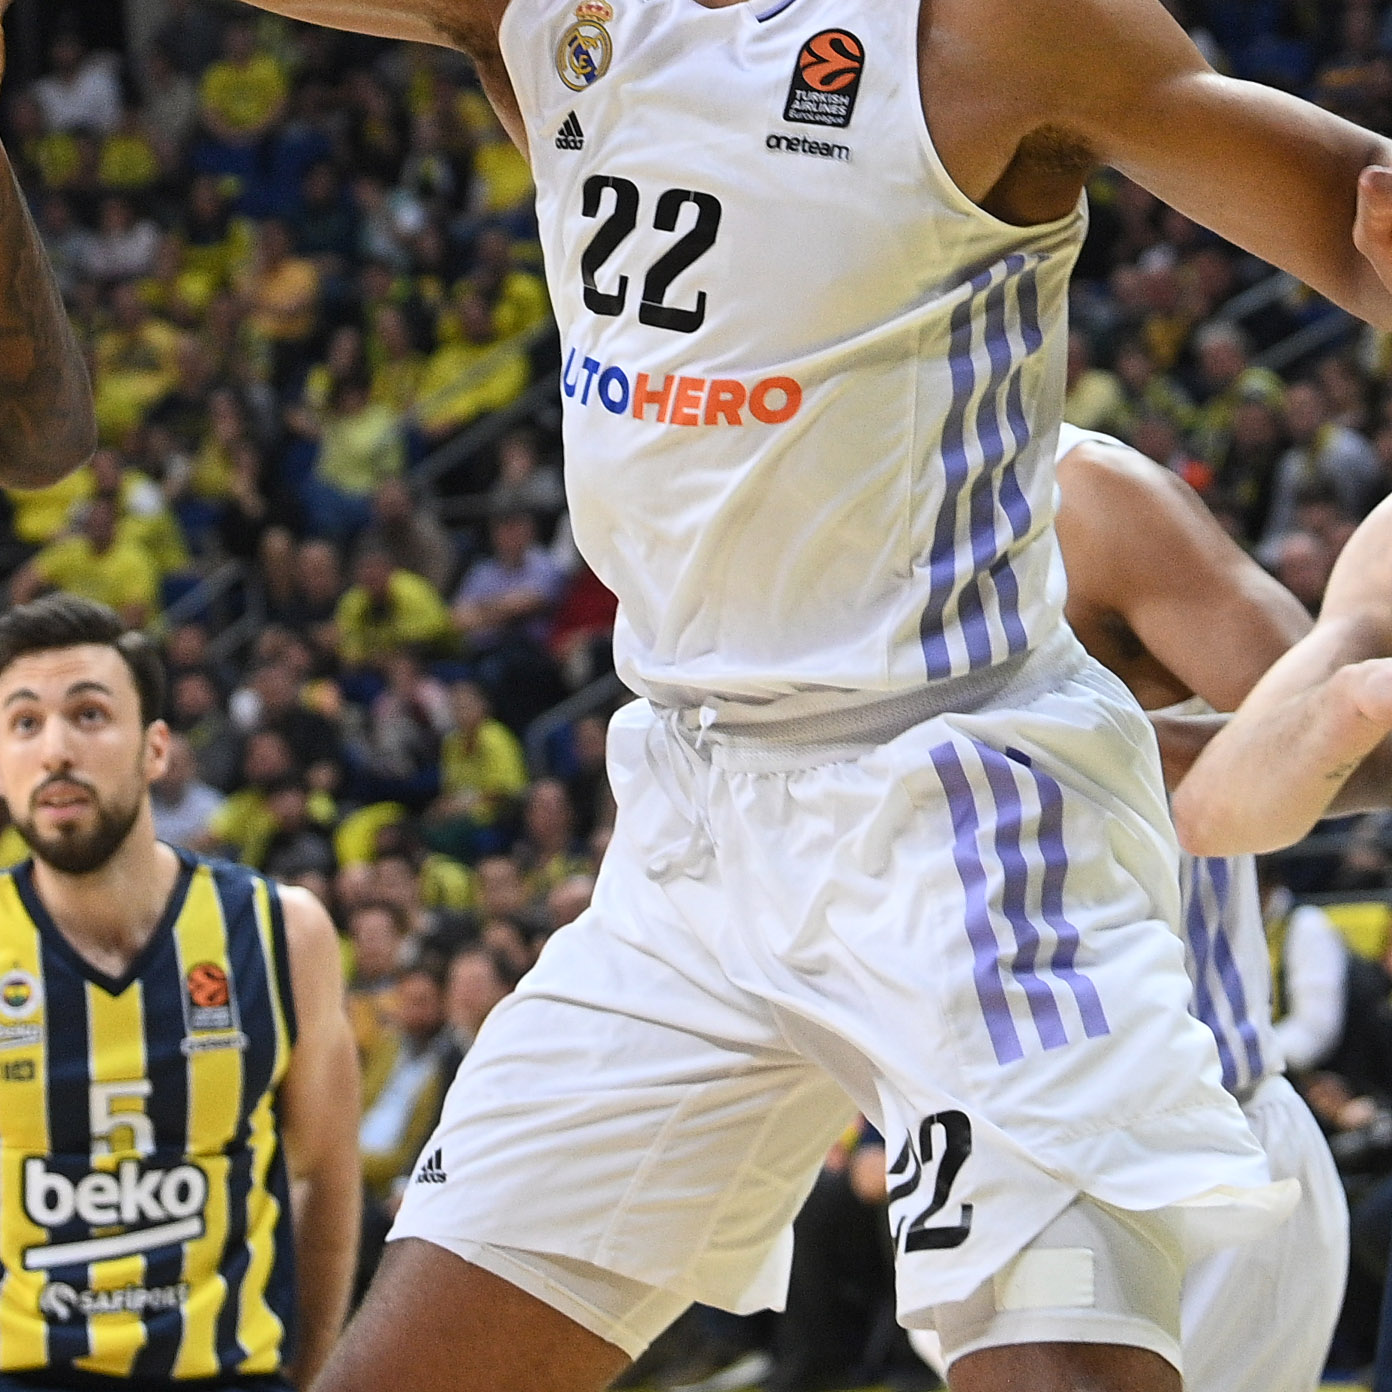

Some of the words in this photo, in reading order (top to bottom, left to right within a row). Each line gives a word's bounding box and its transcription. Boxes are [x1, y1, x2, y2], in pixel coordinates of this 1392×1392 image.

[766, 134, 850, 160] oneteam
[581, 175, 722, 334] 22
[563, 347, 803, 427] UTOHERO
[89, 1080, 156, 1159] 5
[25, 1158, 206, 1226] beko
